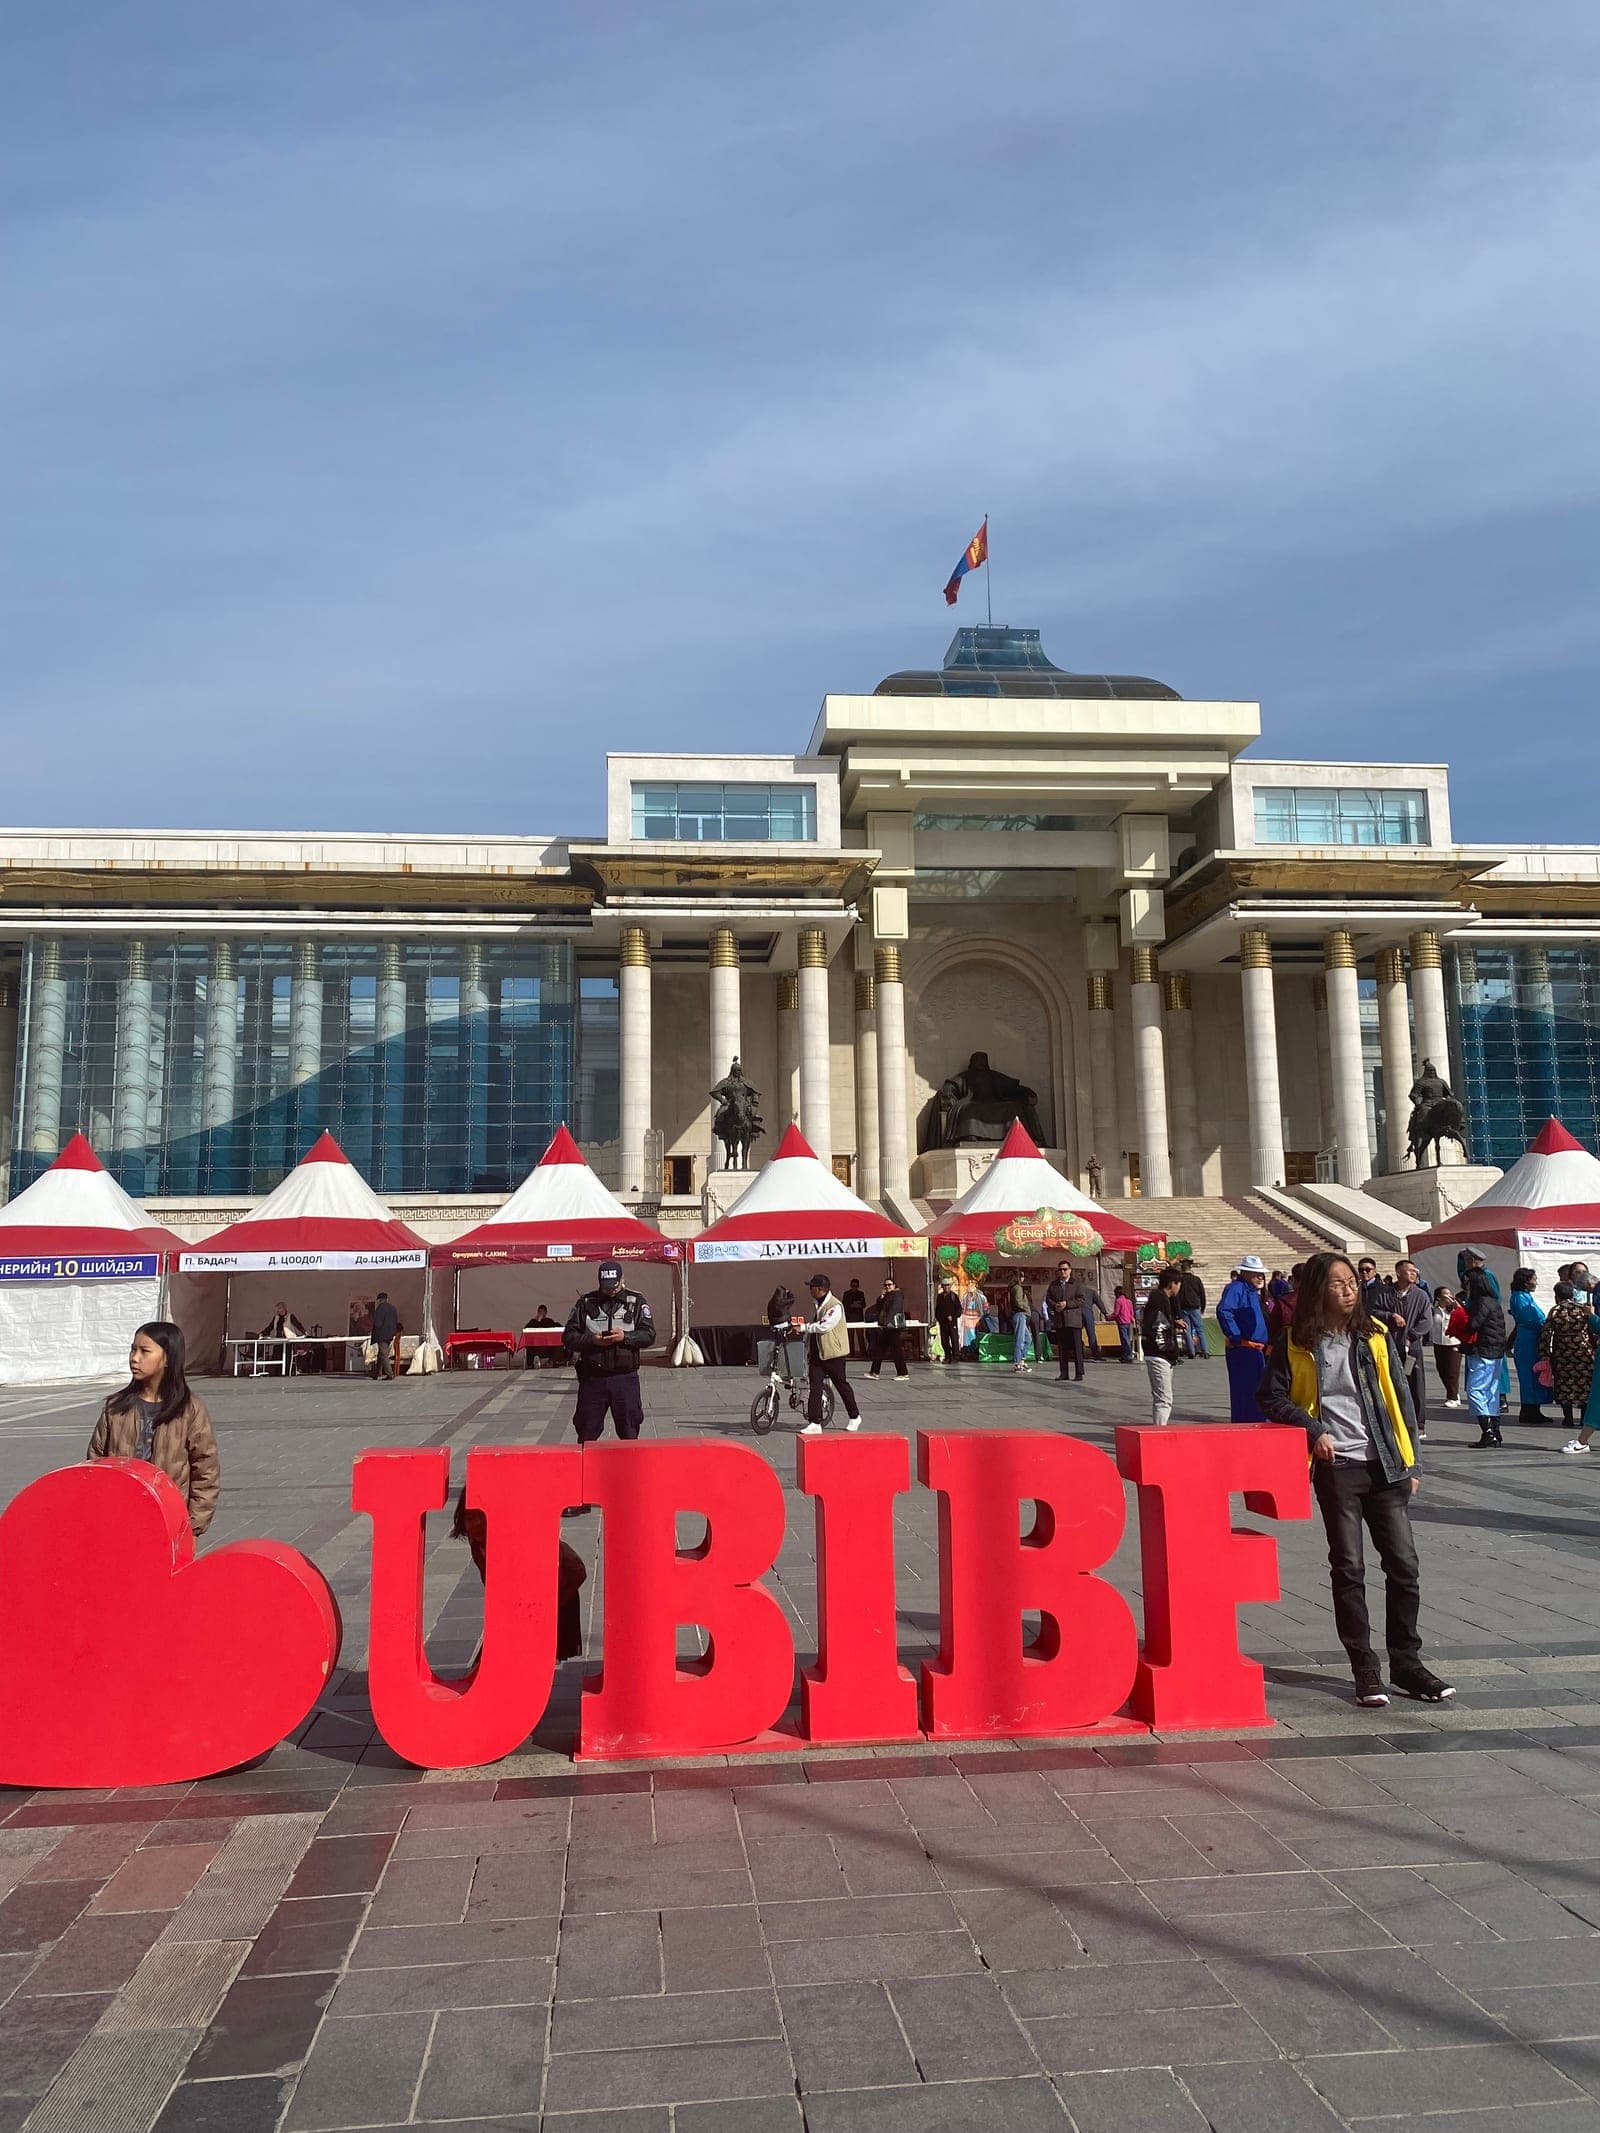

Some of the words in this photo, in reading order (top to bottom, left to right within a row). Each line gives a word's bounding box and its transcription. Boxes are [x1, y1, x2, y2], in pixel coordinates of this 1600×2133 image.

[1059, 1228, 1087, 1238] KHAN
[760, 1239, 868, 1258] Д.УРИАНХАЙ
[197, 1257, 238, 1266] БАДАРЧ
[281, 1255, 322, 1265] ЦООДОЛ
[53, 1259, 79, 1276] 10
[81, 1260, 143, 1275] ШИЙДЭЛ
[352, 1424, 1311, 1770] UBIBF
